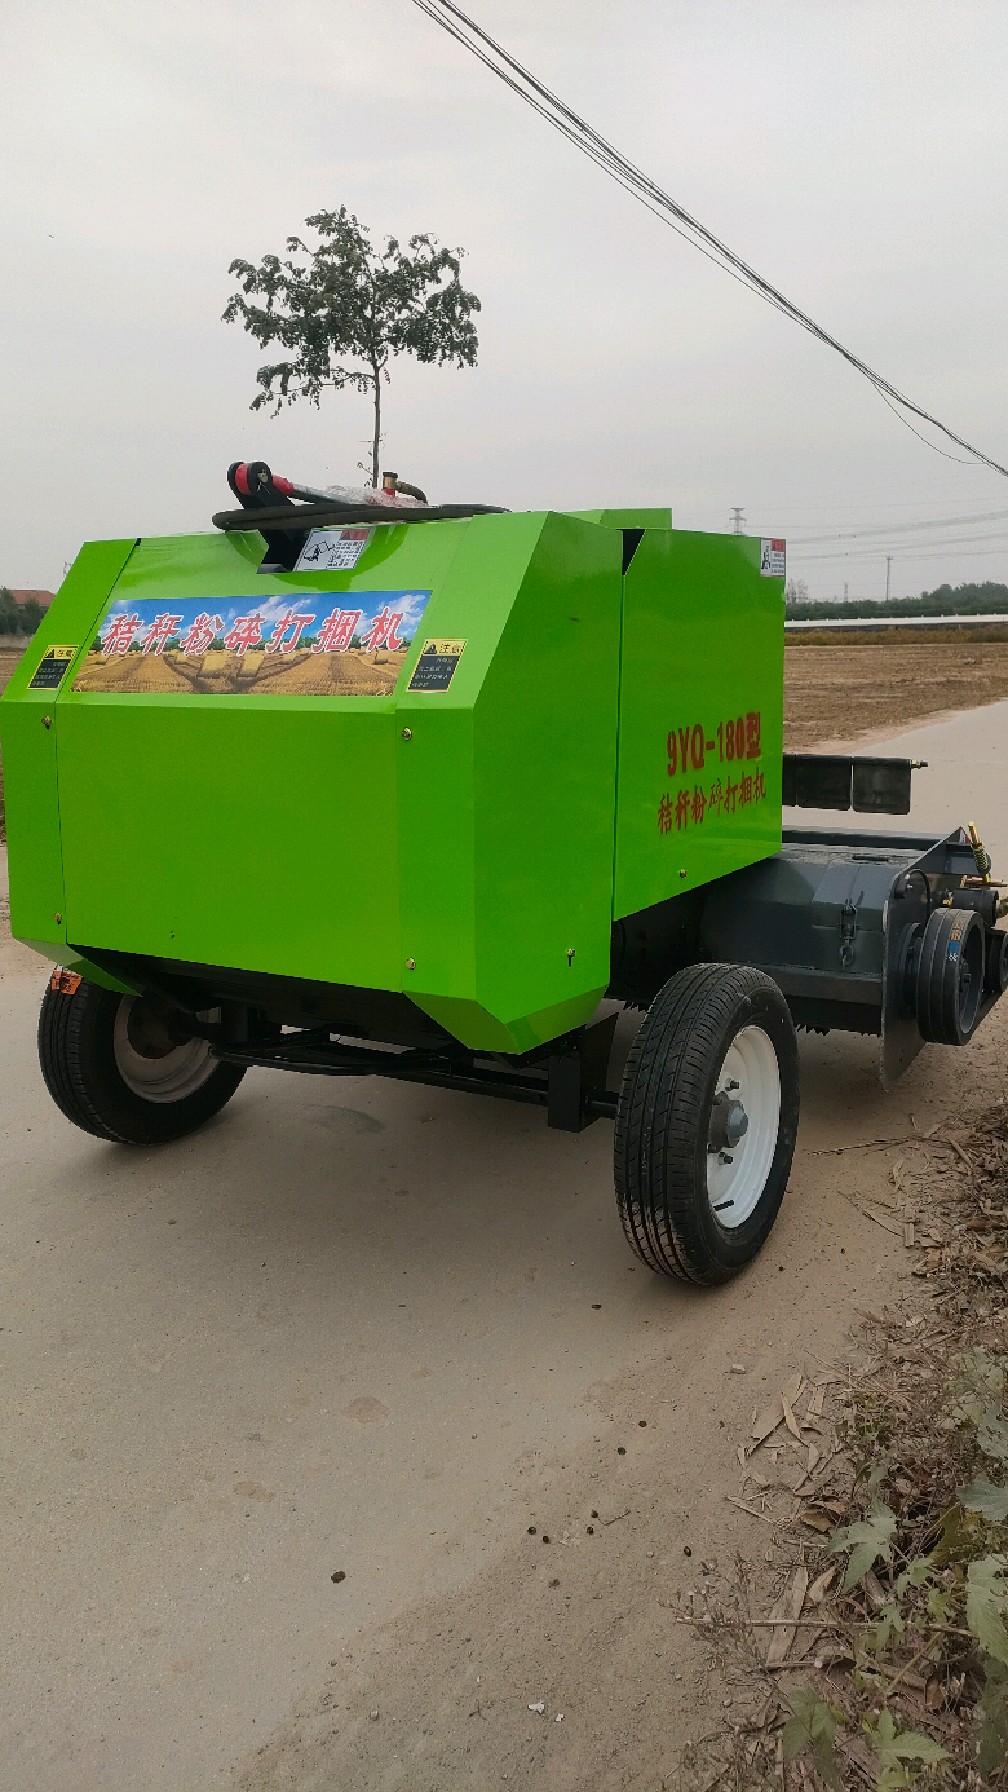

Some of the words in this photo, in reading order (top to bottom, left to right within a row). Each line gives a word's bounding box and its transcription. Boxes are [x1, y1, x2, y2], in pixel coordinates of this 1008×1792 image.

[101, 606, 404, 656] 秸秆粉碎打捆机
[667, 711, 761, 777] 9YQ-180型
[657, 766, 766, 835] 秸秆粉碎打捆机
